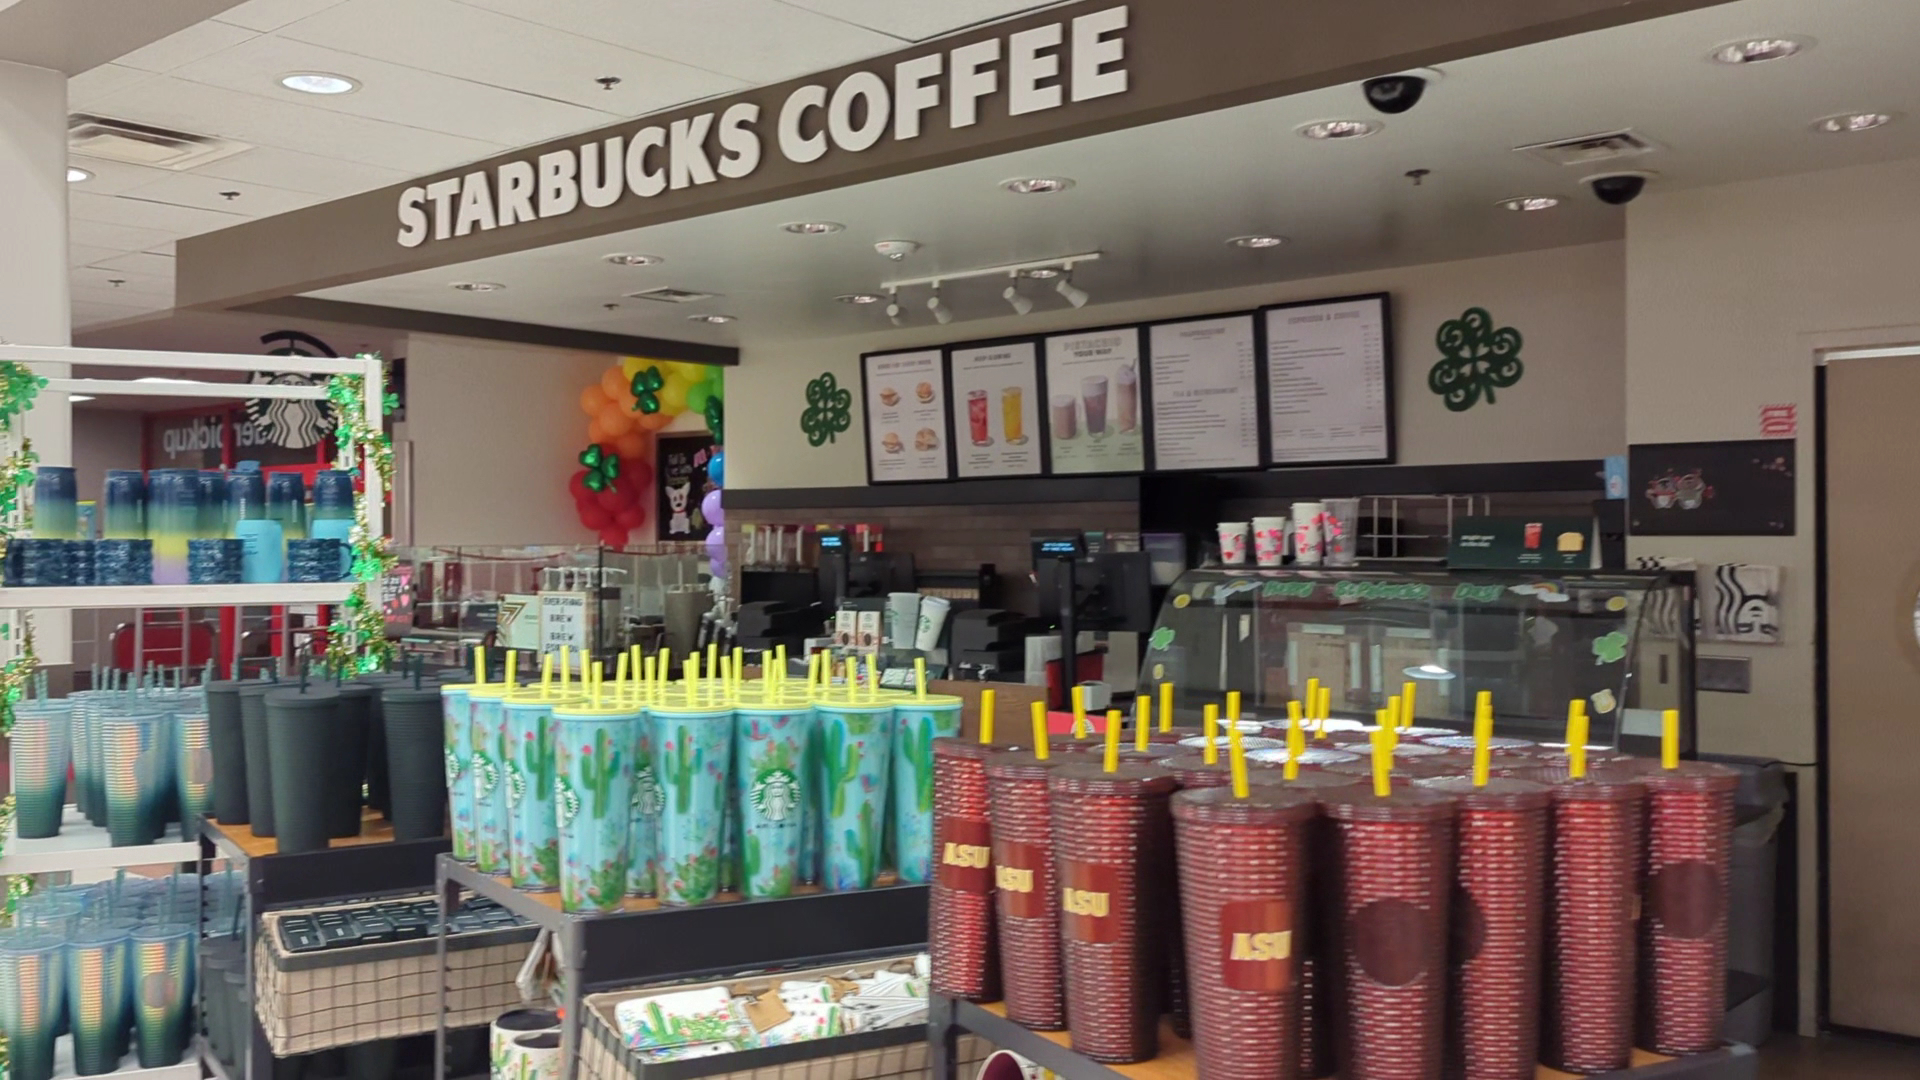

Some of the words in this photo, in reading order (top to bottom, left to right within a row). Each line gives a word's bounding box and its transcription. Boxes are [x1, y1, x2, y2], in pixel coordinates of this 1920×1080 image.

[397, 103, 761, 248] STARBUCKS
[777, 5, 1128, 163] COFFEE
[942, 842, 990, 868] ASU
[1230, 930, 1292, 961] ASU
